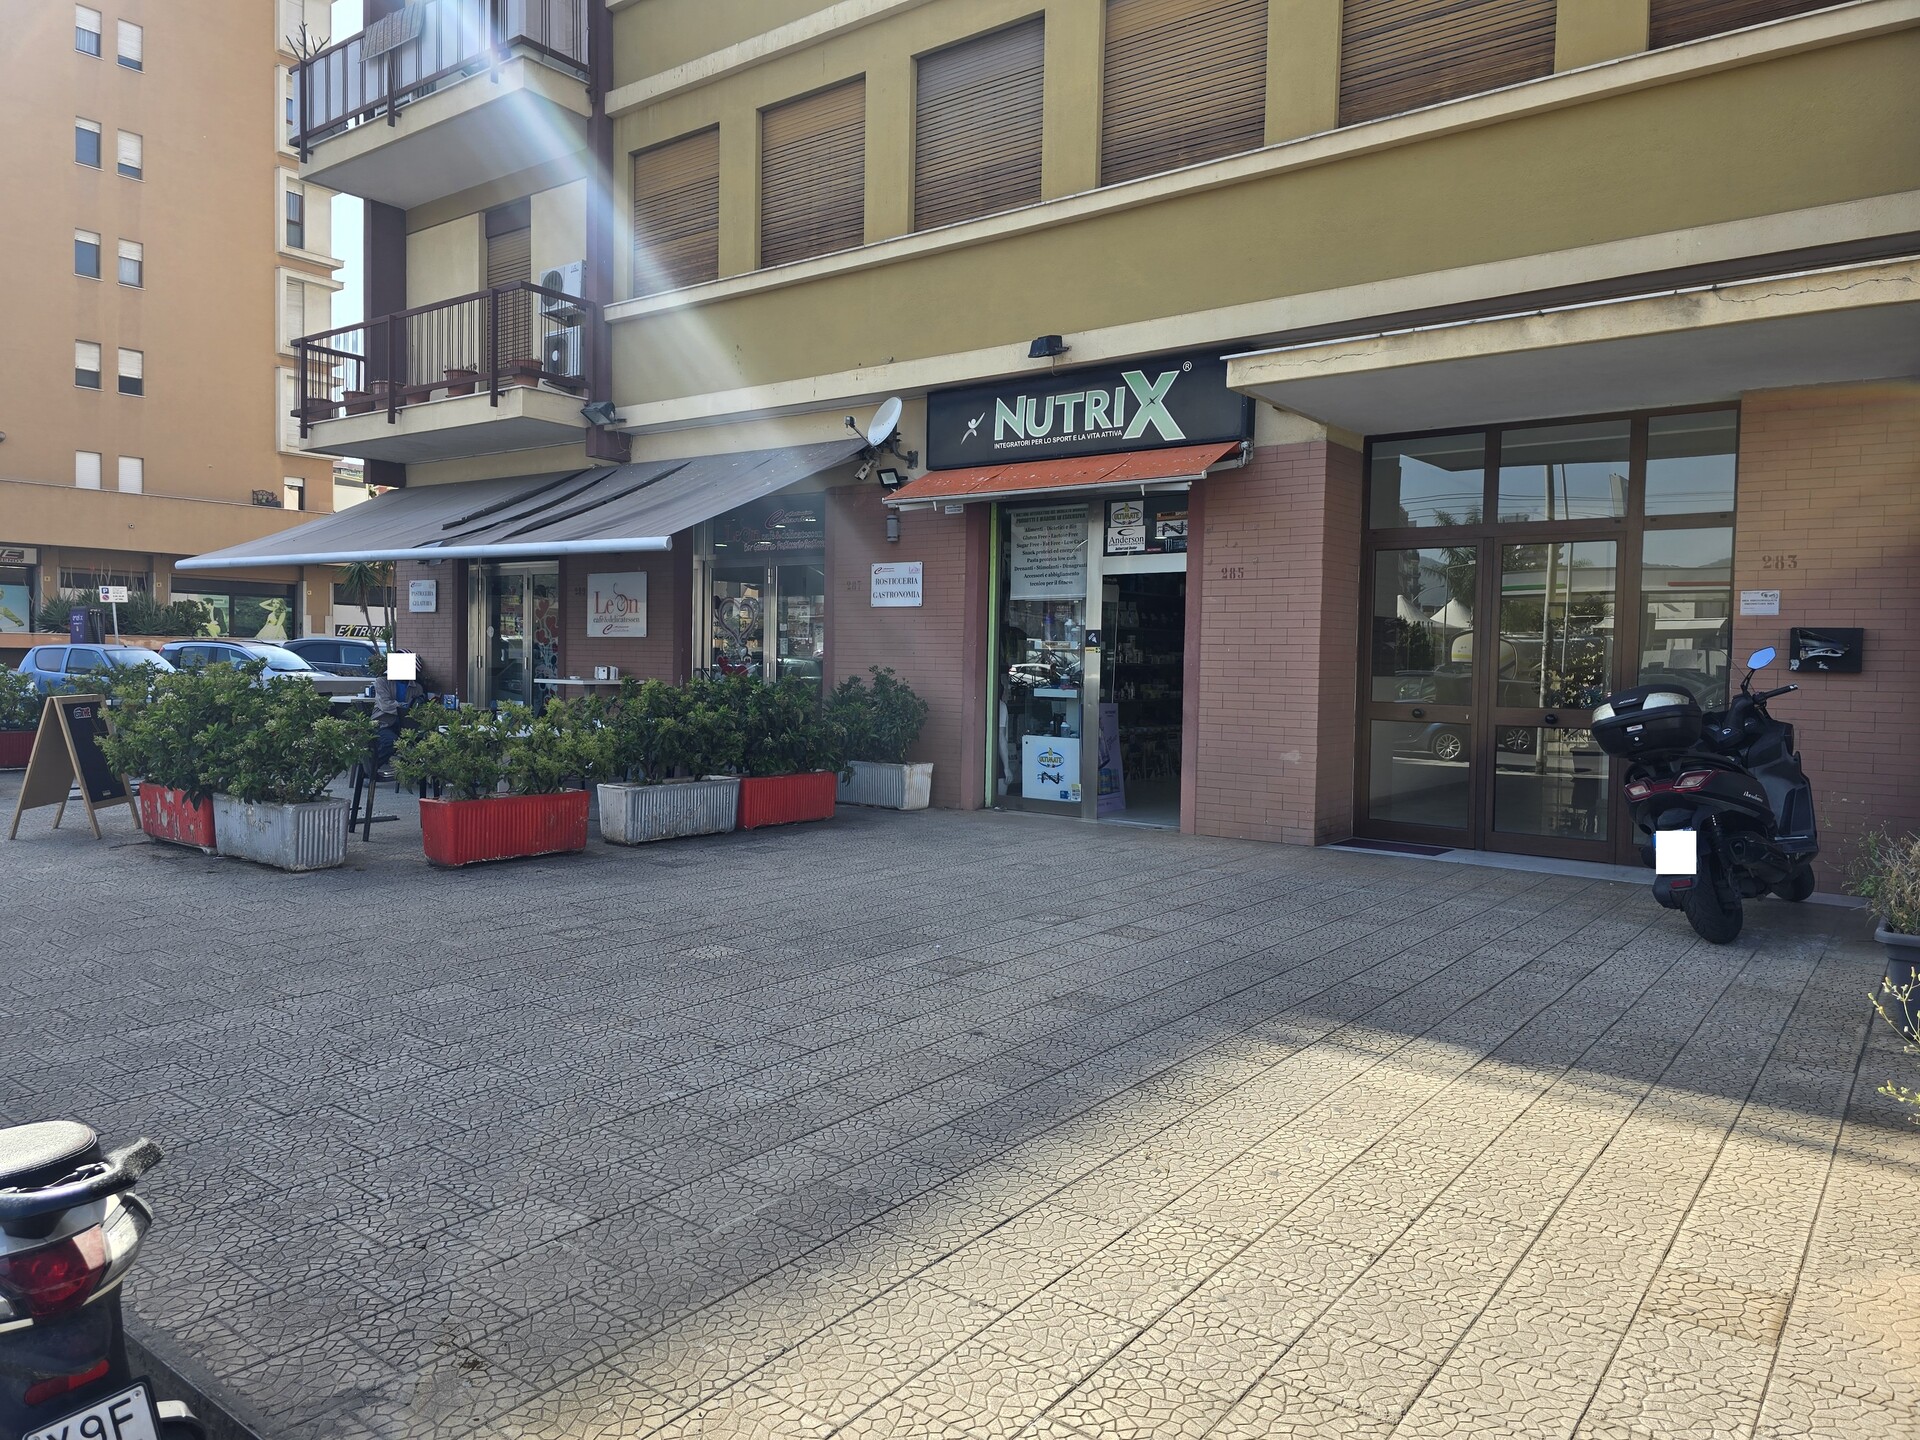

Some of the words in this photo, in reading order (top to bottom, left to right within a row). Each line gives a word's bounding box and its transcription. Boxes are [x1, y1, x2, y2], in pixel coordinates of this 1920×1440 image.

[994, 441, 1030, 449] INTEGRATORI
[1109, 536, 1144, 544] Anderson
[1762, 555, 1798, 570] 283
[1221, 567, 1244, 579] 285
[875, 577, 918, 585] ROSTICCERIA
[336, 625, 387, 637] EXTREM
